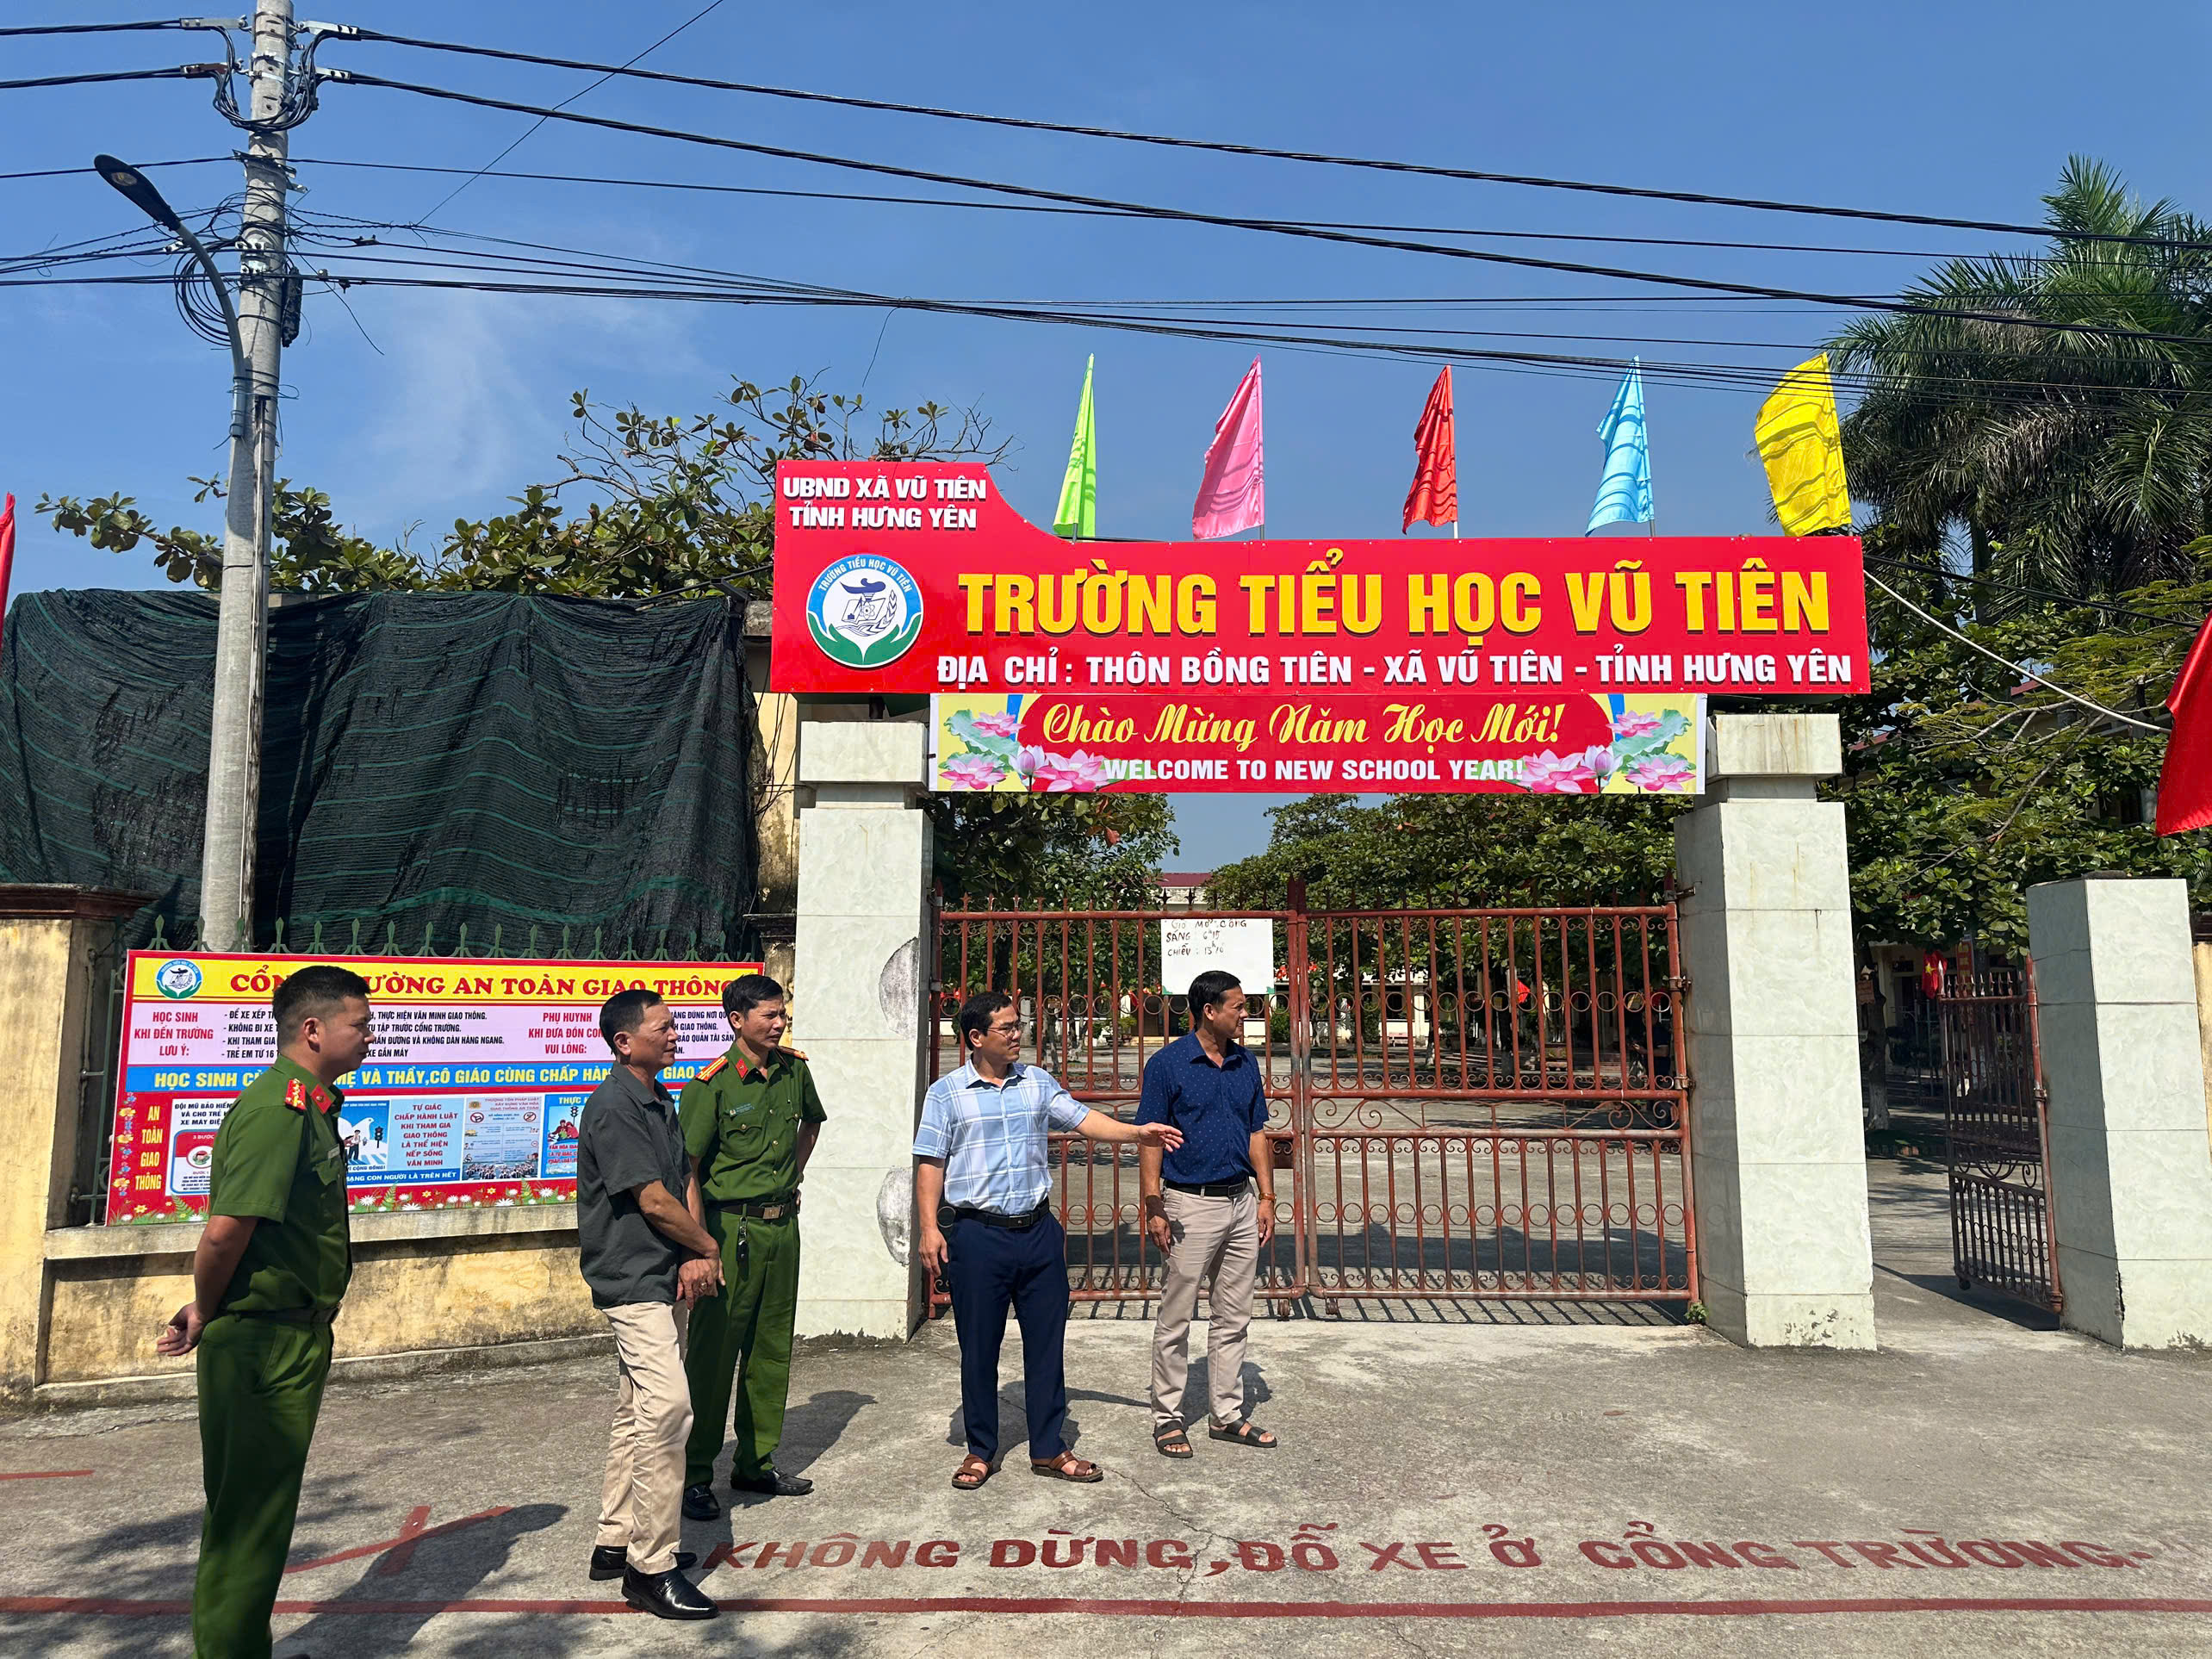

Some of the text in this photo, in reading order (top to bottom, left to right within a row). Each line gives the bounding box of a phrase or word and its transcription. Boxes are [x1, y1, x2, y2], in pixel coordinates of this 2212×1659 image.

[782, 475, 987, 500] UBND XÃ VŨ TIÊN
[789, 499, 978, 530] TỈNH HƯNG YÊN
[958, 547, 1830, 648] TRƯỜNG TIỂU HỌC VŨ TIÊN
[936, 655, 989, 691] ĐỊA
[1086, 651, 1171, 686] THÔN
[1181, 647, 1269, 686] BỒNG
[1279, 649, 1351, 686] TIÊN
[1382, 649, 1425, 686] XÃ
[1439, 648, 1481, 685] VŨ
[1489, 648, 1563, 684] TIÊN
[1595, 643, 1672, 684] TỈNH
[1683, 652, 1776, 684] HƯNG
[1790, 648, 1852, 684] YÊN
[1042, 702, 1563, 754] Chào Mừng Năm Học Mới!
[1103, 758, 1524, 781] WELCOME TO NEW SCHOOL YEAR!
[452, 977, 494, 995] AN
[500, 973, 576, 996] TOÀN
[152, 1011, 199, 1025] HỌC SINH
[240, 1010, 251, 1019] XE
[428, 1011, 446, 1020] MINH
[447, 1011, 463, 1020] GIAO
[543, 1012, 593, 1026] PHỤ HUYNH
[134, 1025, 214, 1040] KHI ĐẾN TRƯỜNG
[264, 1023, 274, 1032] XE
[528, 1028, 544, 1039] KHI
[545, 1027, 564, 1039] ĐƯA
[565, 1026, 584, 1039] ĐÓN
[680, 1022, 695, 1031] GIAO
[227, 1036, 276, 1045] KHI THAM GIA
[159, 1045, 177, 1056] LƯU
[241, 1049, 253, 1058] EM
[265, 1049, 275, 1058] 16
[545, 1044, 560, 1054] VUI
[154, 1072, 190, 1090] HỌC
[196, 1072, 239, 1087] SINH
[361, 1067, 382, 1085] VÀ
[455, 1067, 490, 1084] GIÁO
[494, 1066, 535, 1084] CÙNG
[540, 1064, 579, 1082] CHẤP
[582, 1066, 612, 1082] HÀN
[662, 1066, 695, 1080] GIAO
[147, 1105, 161, 1122] AN
[141, 1124, 164, 1145] TOÀN
[422, 1130, 448, 1139] THÔNG
[140, 1151, 161, 1168] GIAO
[134, 1171, 163, 1191] THÔNG
[701, 1532, 960, 1569] KHÔNG
[1358, 1541, 1466, 1570] XE
[1482, 1524, 1542, 1568] Ở
[1578, 1520, 1801, 1569] CỔNG
